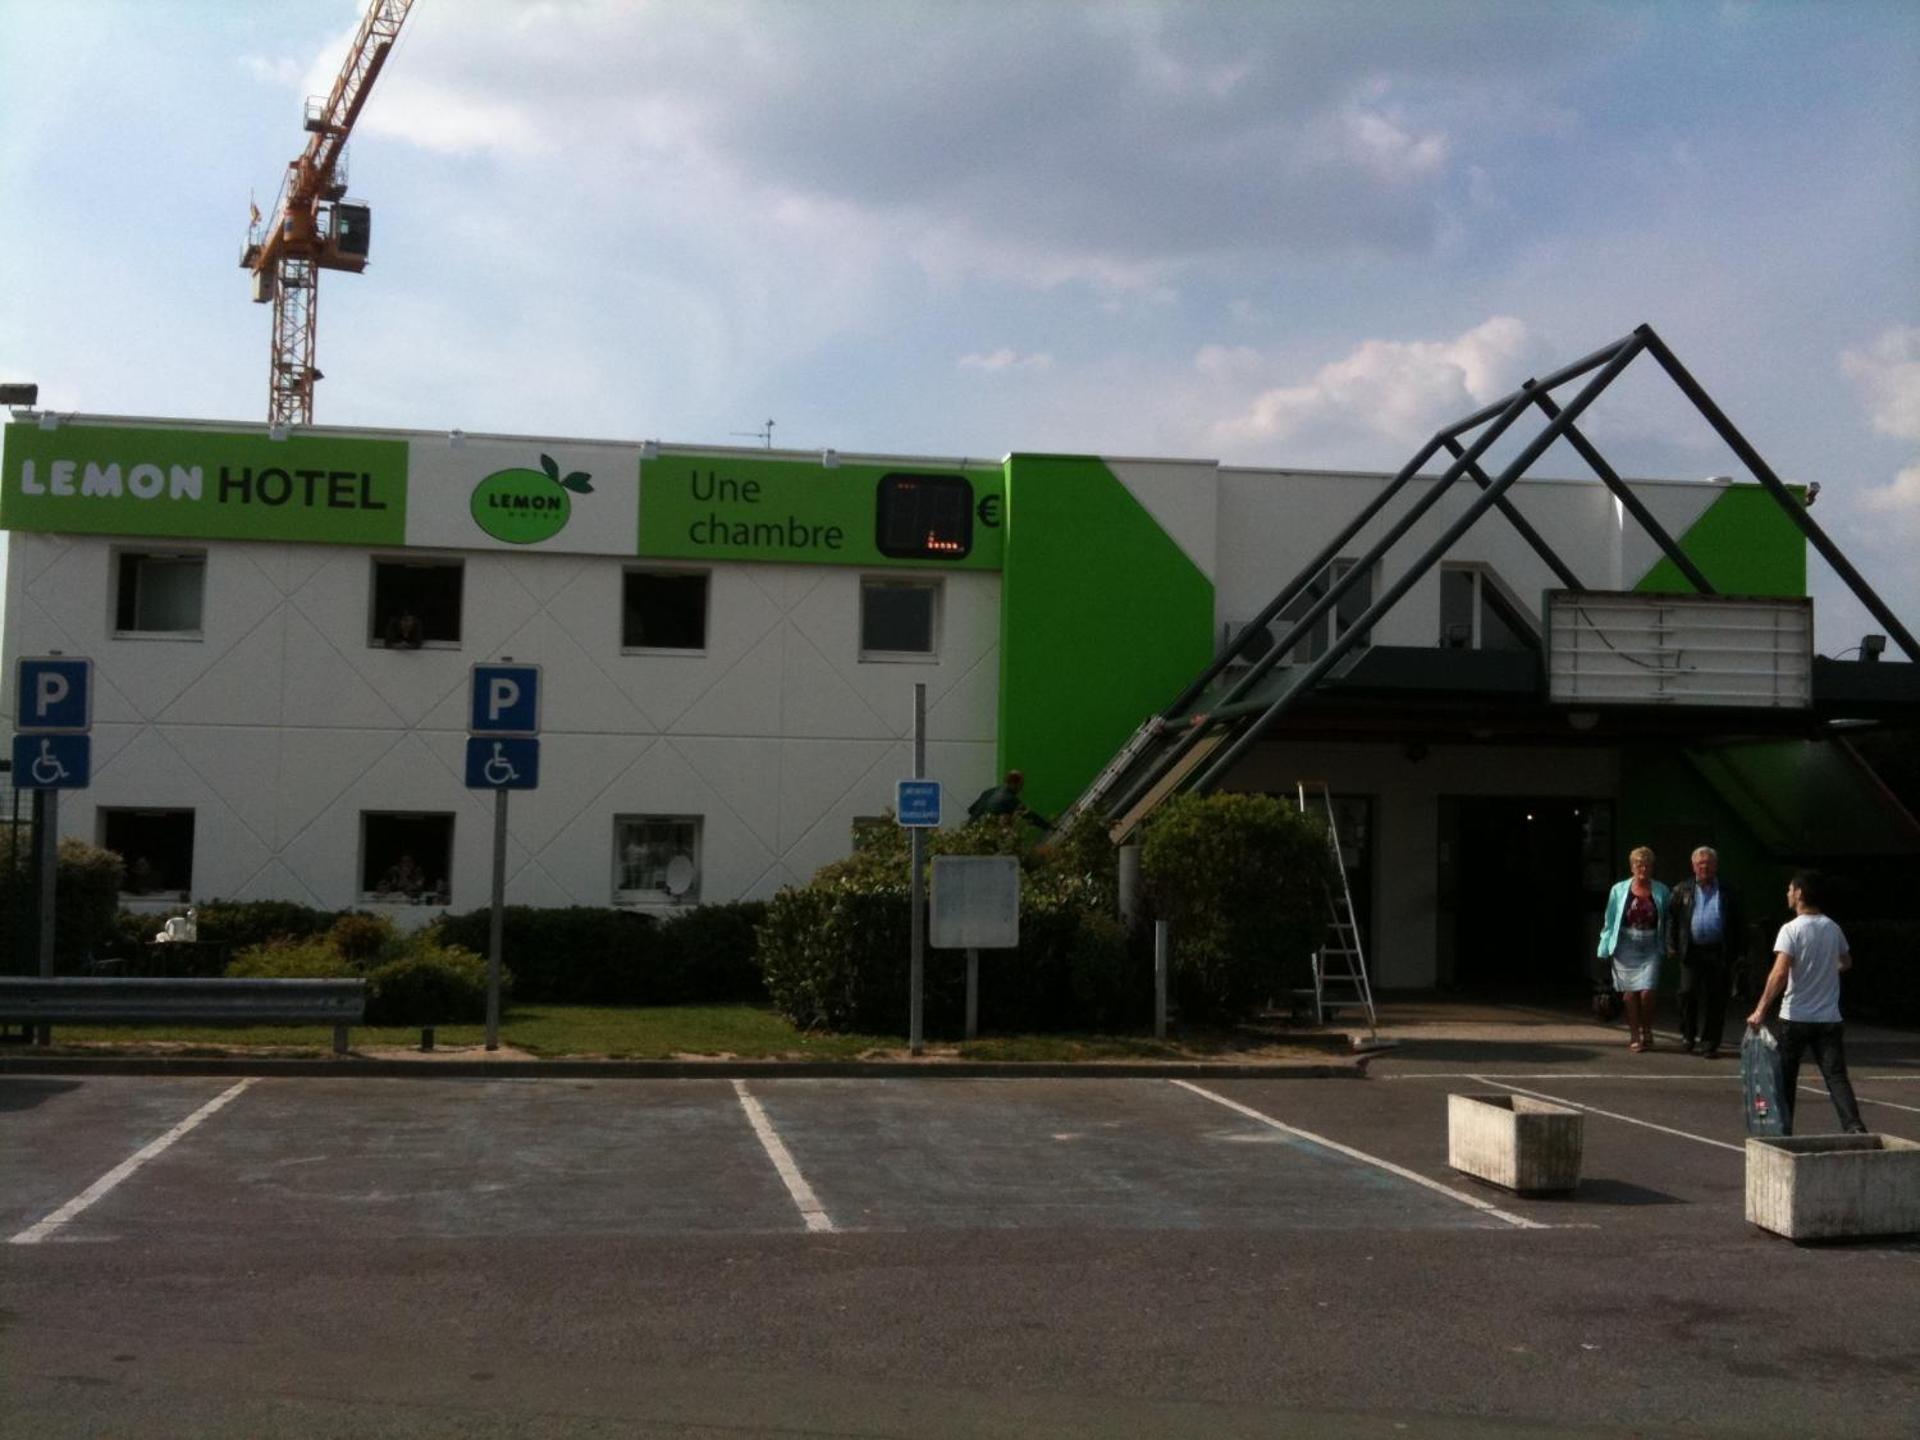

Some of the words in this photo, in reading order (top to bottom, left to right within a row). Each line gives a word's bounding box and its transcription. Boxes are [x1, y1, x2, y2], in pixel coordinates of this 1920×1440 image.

[21, 459, 203, 501] LEMON
[218, 466, 388, 511] HOTEL
[490, 494, 561, 510] LEMON
[690, 470, 762, 504] Une
[977, 494, 1001, 529] €
[689, 512, 844, 551] chambre
[37, 672, 69, 718] P
[489, 678, 521, 721] P
